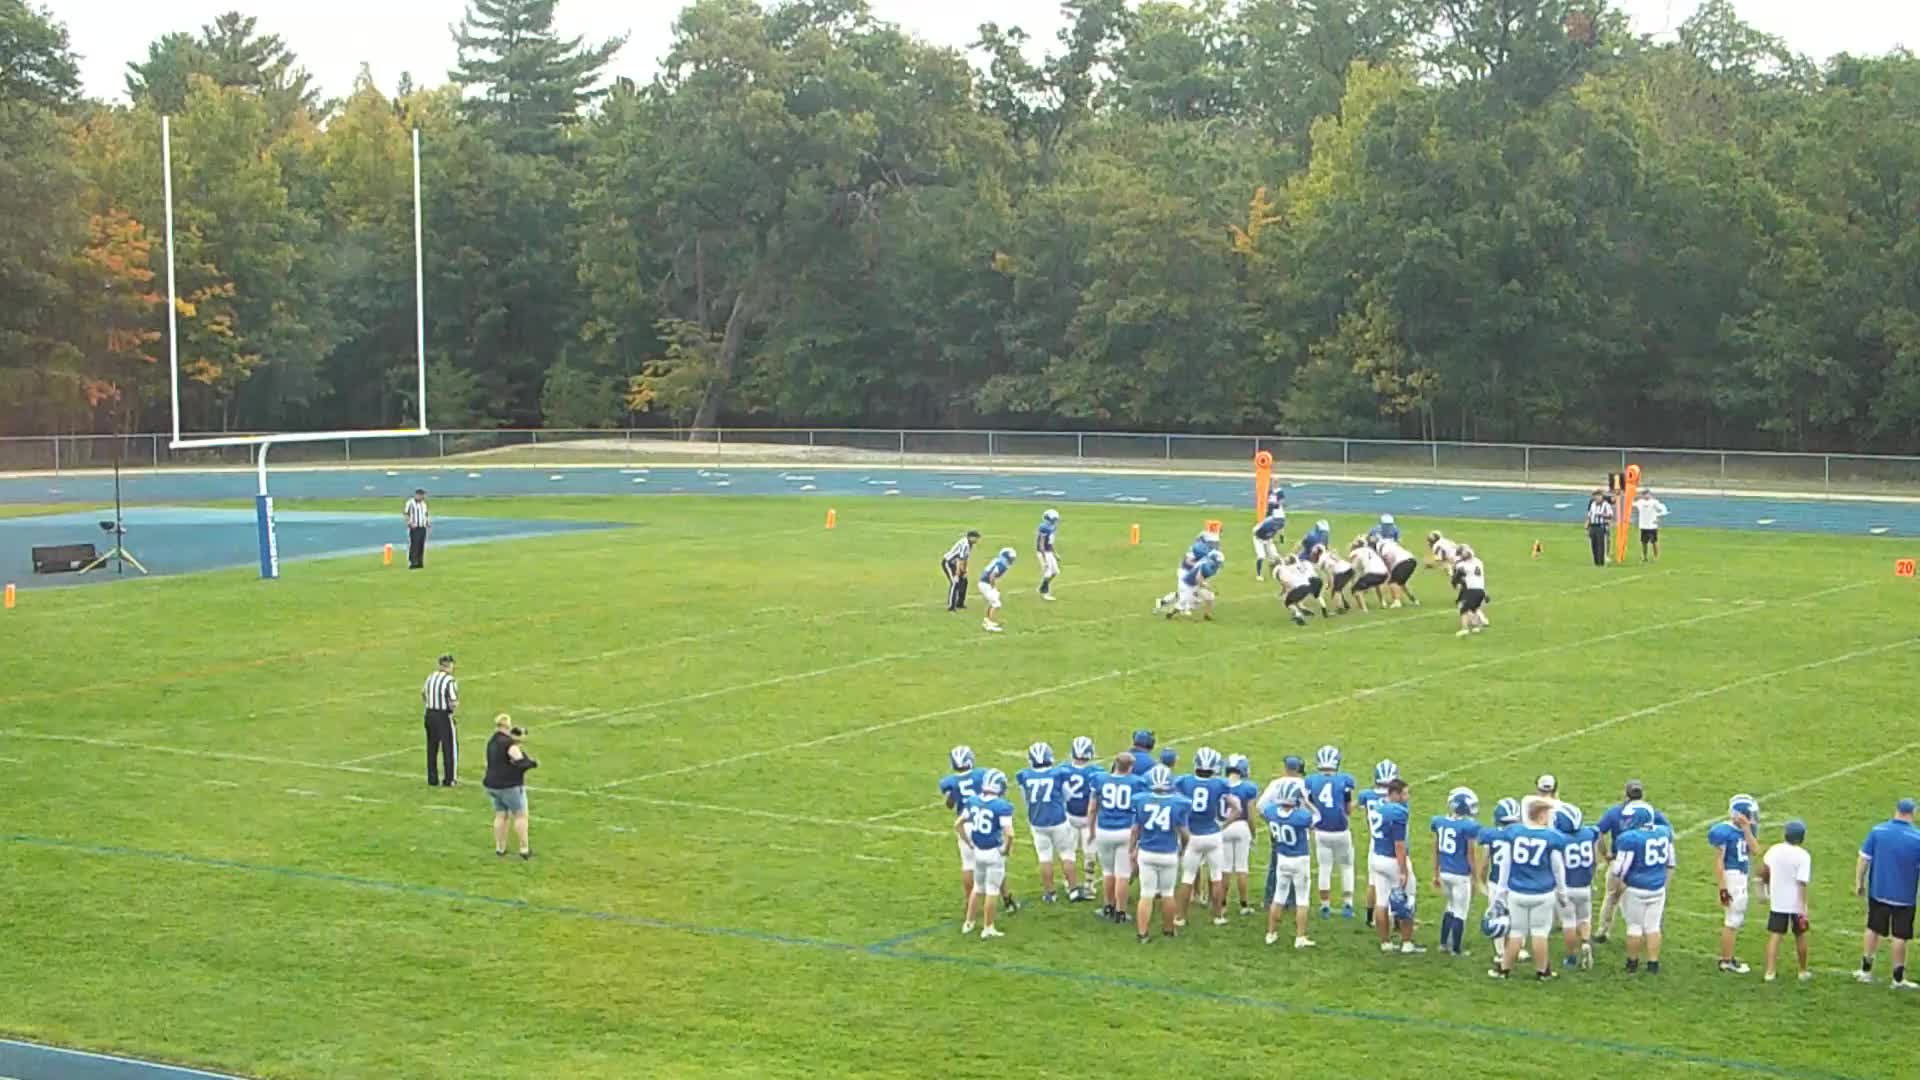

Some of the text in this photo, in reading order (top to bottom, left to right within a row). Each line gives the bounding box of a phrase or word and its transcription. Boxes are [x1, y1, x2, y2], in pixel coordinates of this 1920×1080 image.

[1897, 561, 1913, 574] 20
[958, 779, 976, 803] 5
[1025, 778, 1054, 803] 77
[1102, 783, 1132, 810] 90
[1192, 787, 1208, 812] 8
[1318, 782, 1334, 808] 4
[969, 806, 994, 834] 36
[1144, 804, 1171, 832] 74
[1437, 826, 1457, 854] 16
[1513, 836, 1547, 866] 67
[1645, 837, 1669, 866] 63
[1565, 840, 1593, 868] 69
